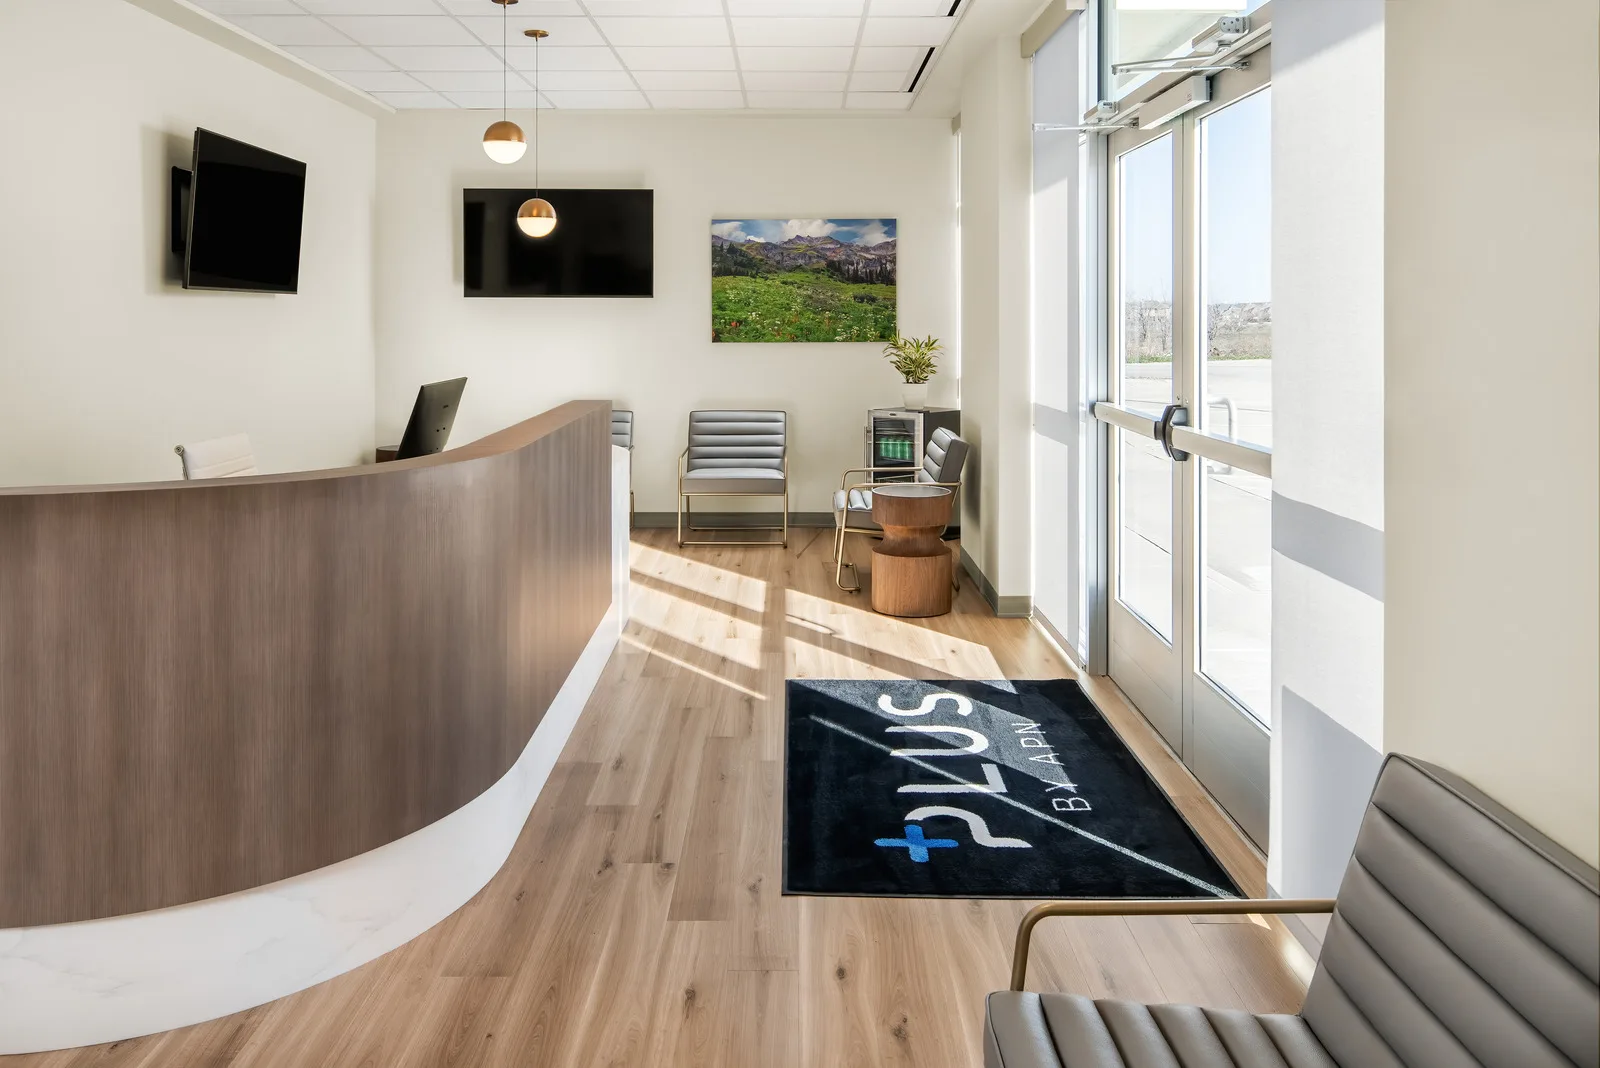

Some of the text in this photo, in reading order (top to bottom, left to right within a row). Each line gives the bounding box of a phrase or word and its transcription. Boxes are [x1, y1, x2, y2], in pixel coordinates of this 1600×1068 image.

[878, 693, 1033, 849] PLUS
[1011, 723, 1092, 811] BY APN
